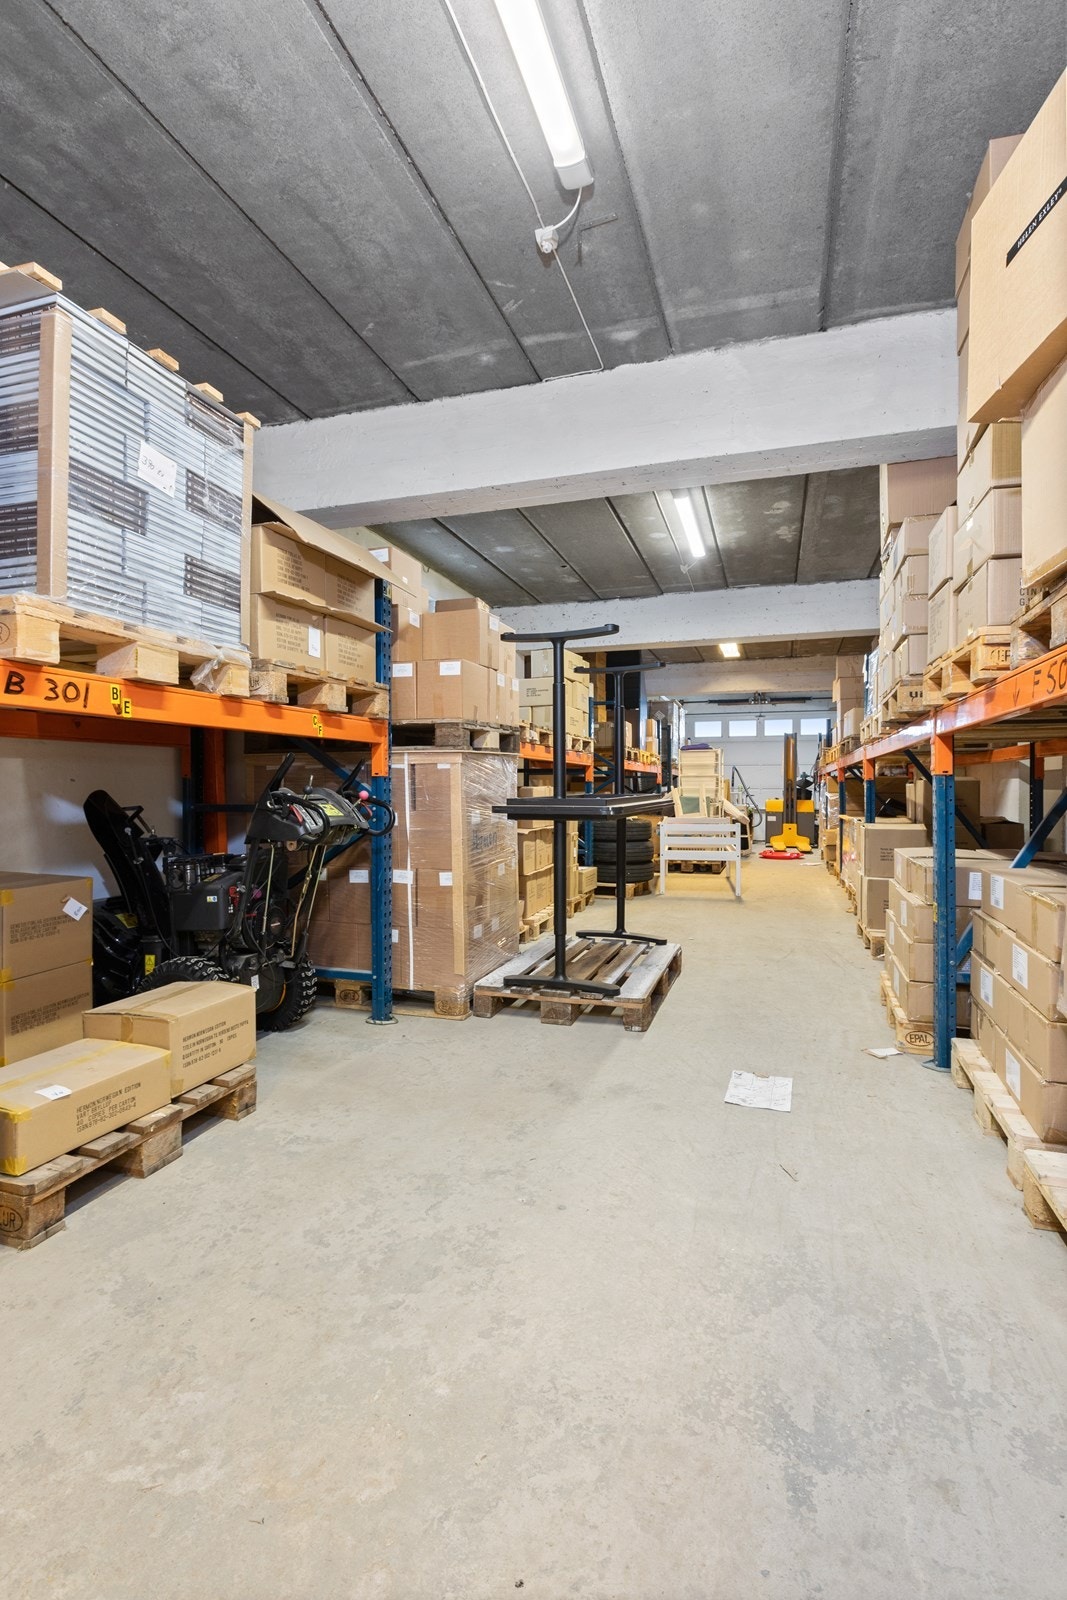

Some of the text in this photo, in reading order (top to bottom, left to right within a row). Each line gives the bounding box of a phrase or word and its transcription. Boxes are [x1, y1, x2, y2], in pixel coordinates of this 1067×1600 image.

[1017, 219, 1038, 249] HELEN
[4, 671, 90, 709] B 301
[111, 687, 119, 701] B
[123, 700, 130, 715] E
[909, 1033, 931, 1044] EPAL
[0, 1210, 16, 1228] UR
